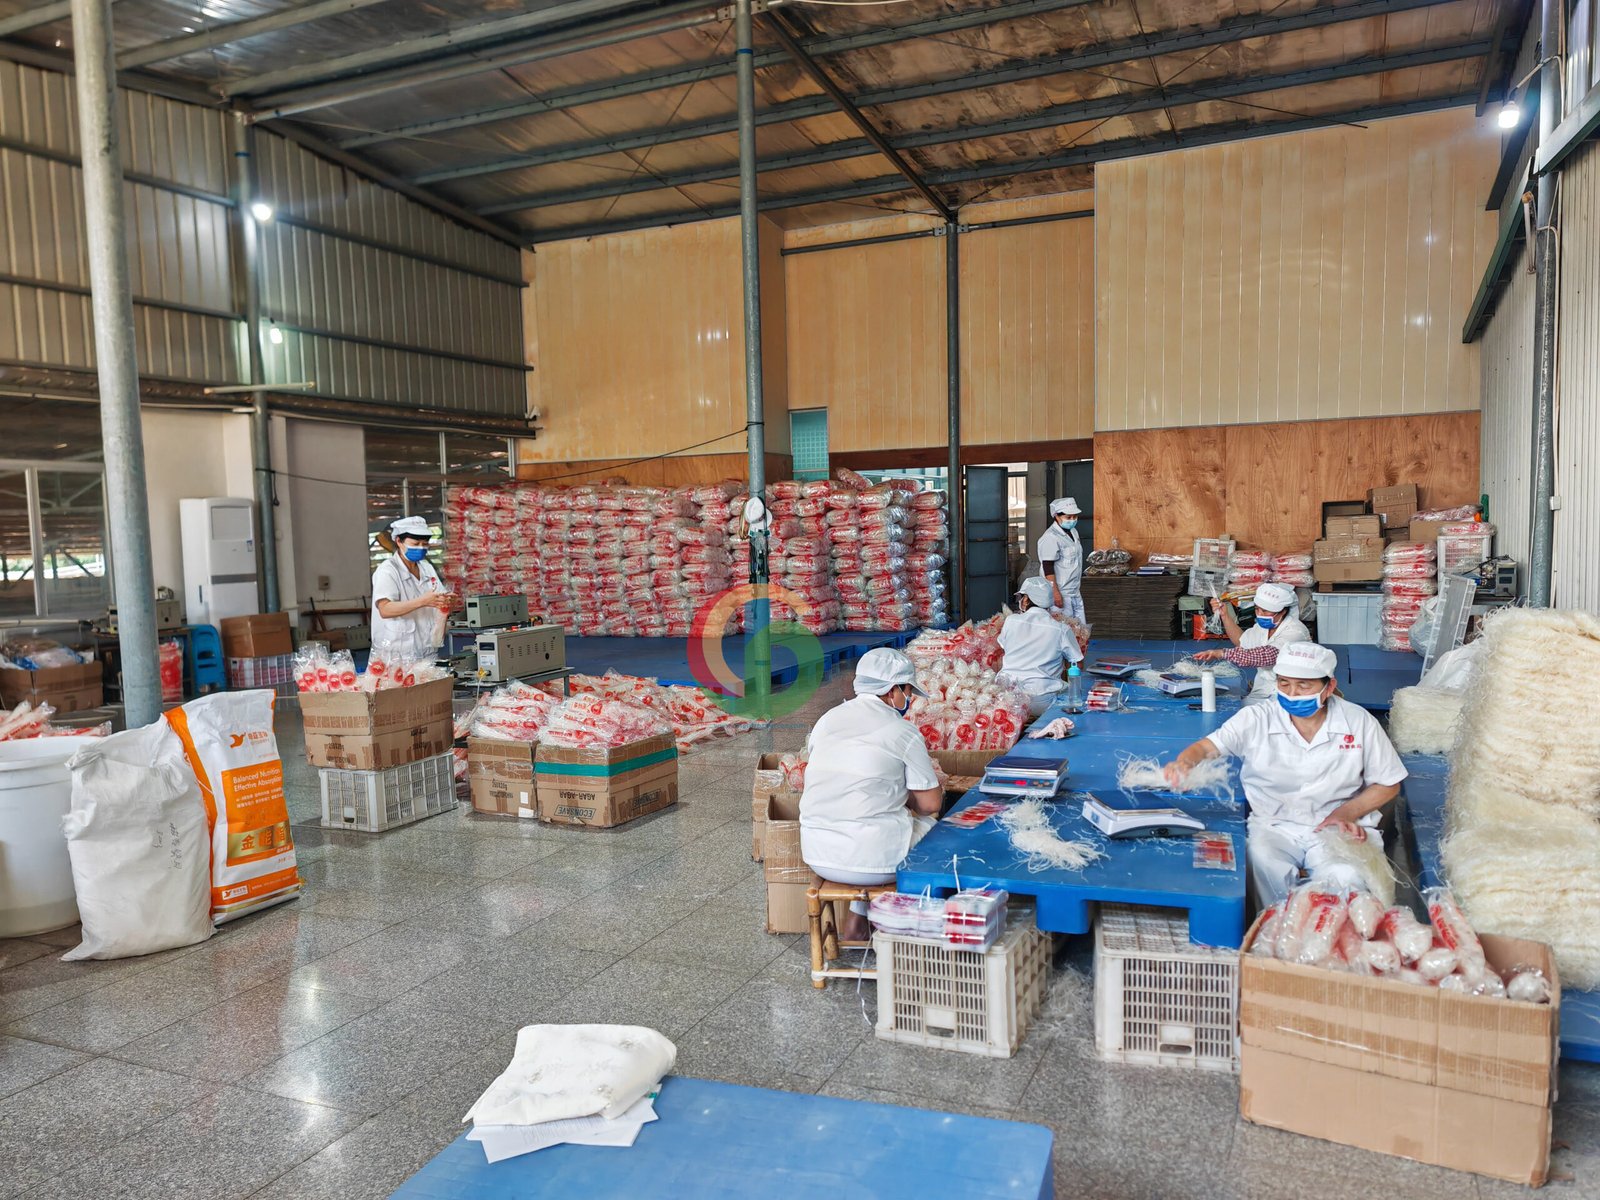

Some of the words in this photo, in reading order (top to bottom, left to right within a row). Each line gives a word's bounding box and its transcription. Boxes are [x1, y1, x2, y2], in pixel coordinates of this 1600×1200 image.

[232, 771, 259, 784] Balanced
[233, 782, 257, 792] Effective
[559, 791, 596, 800] AGAR-AGAR
[557, 806, 593, 818] ECONSAVE
